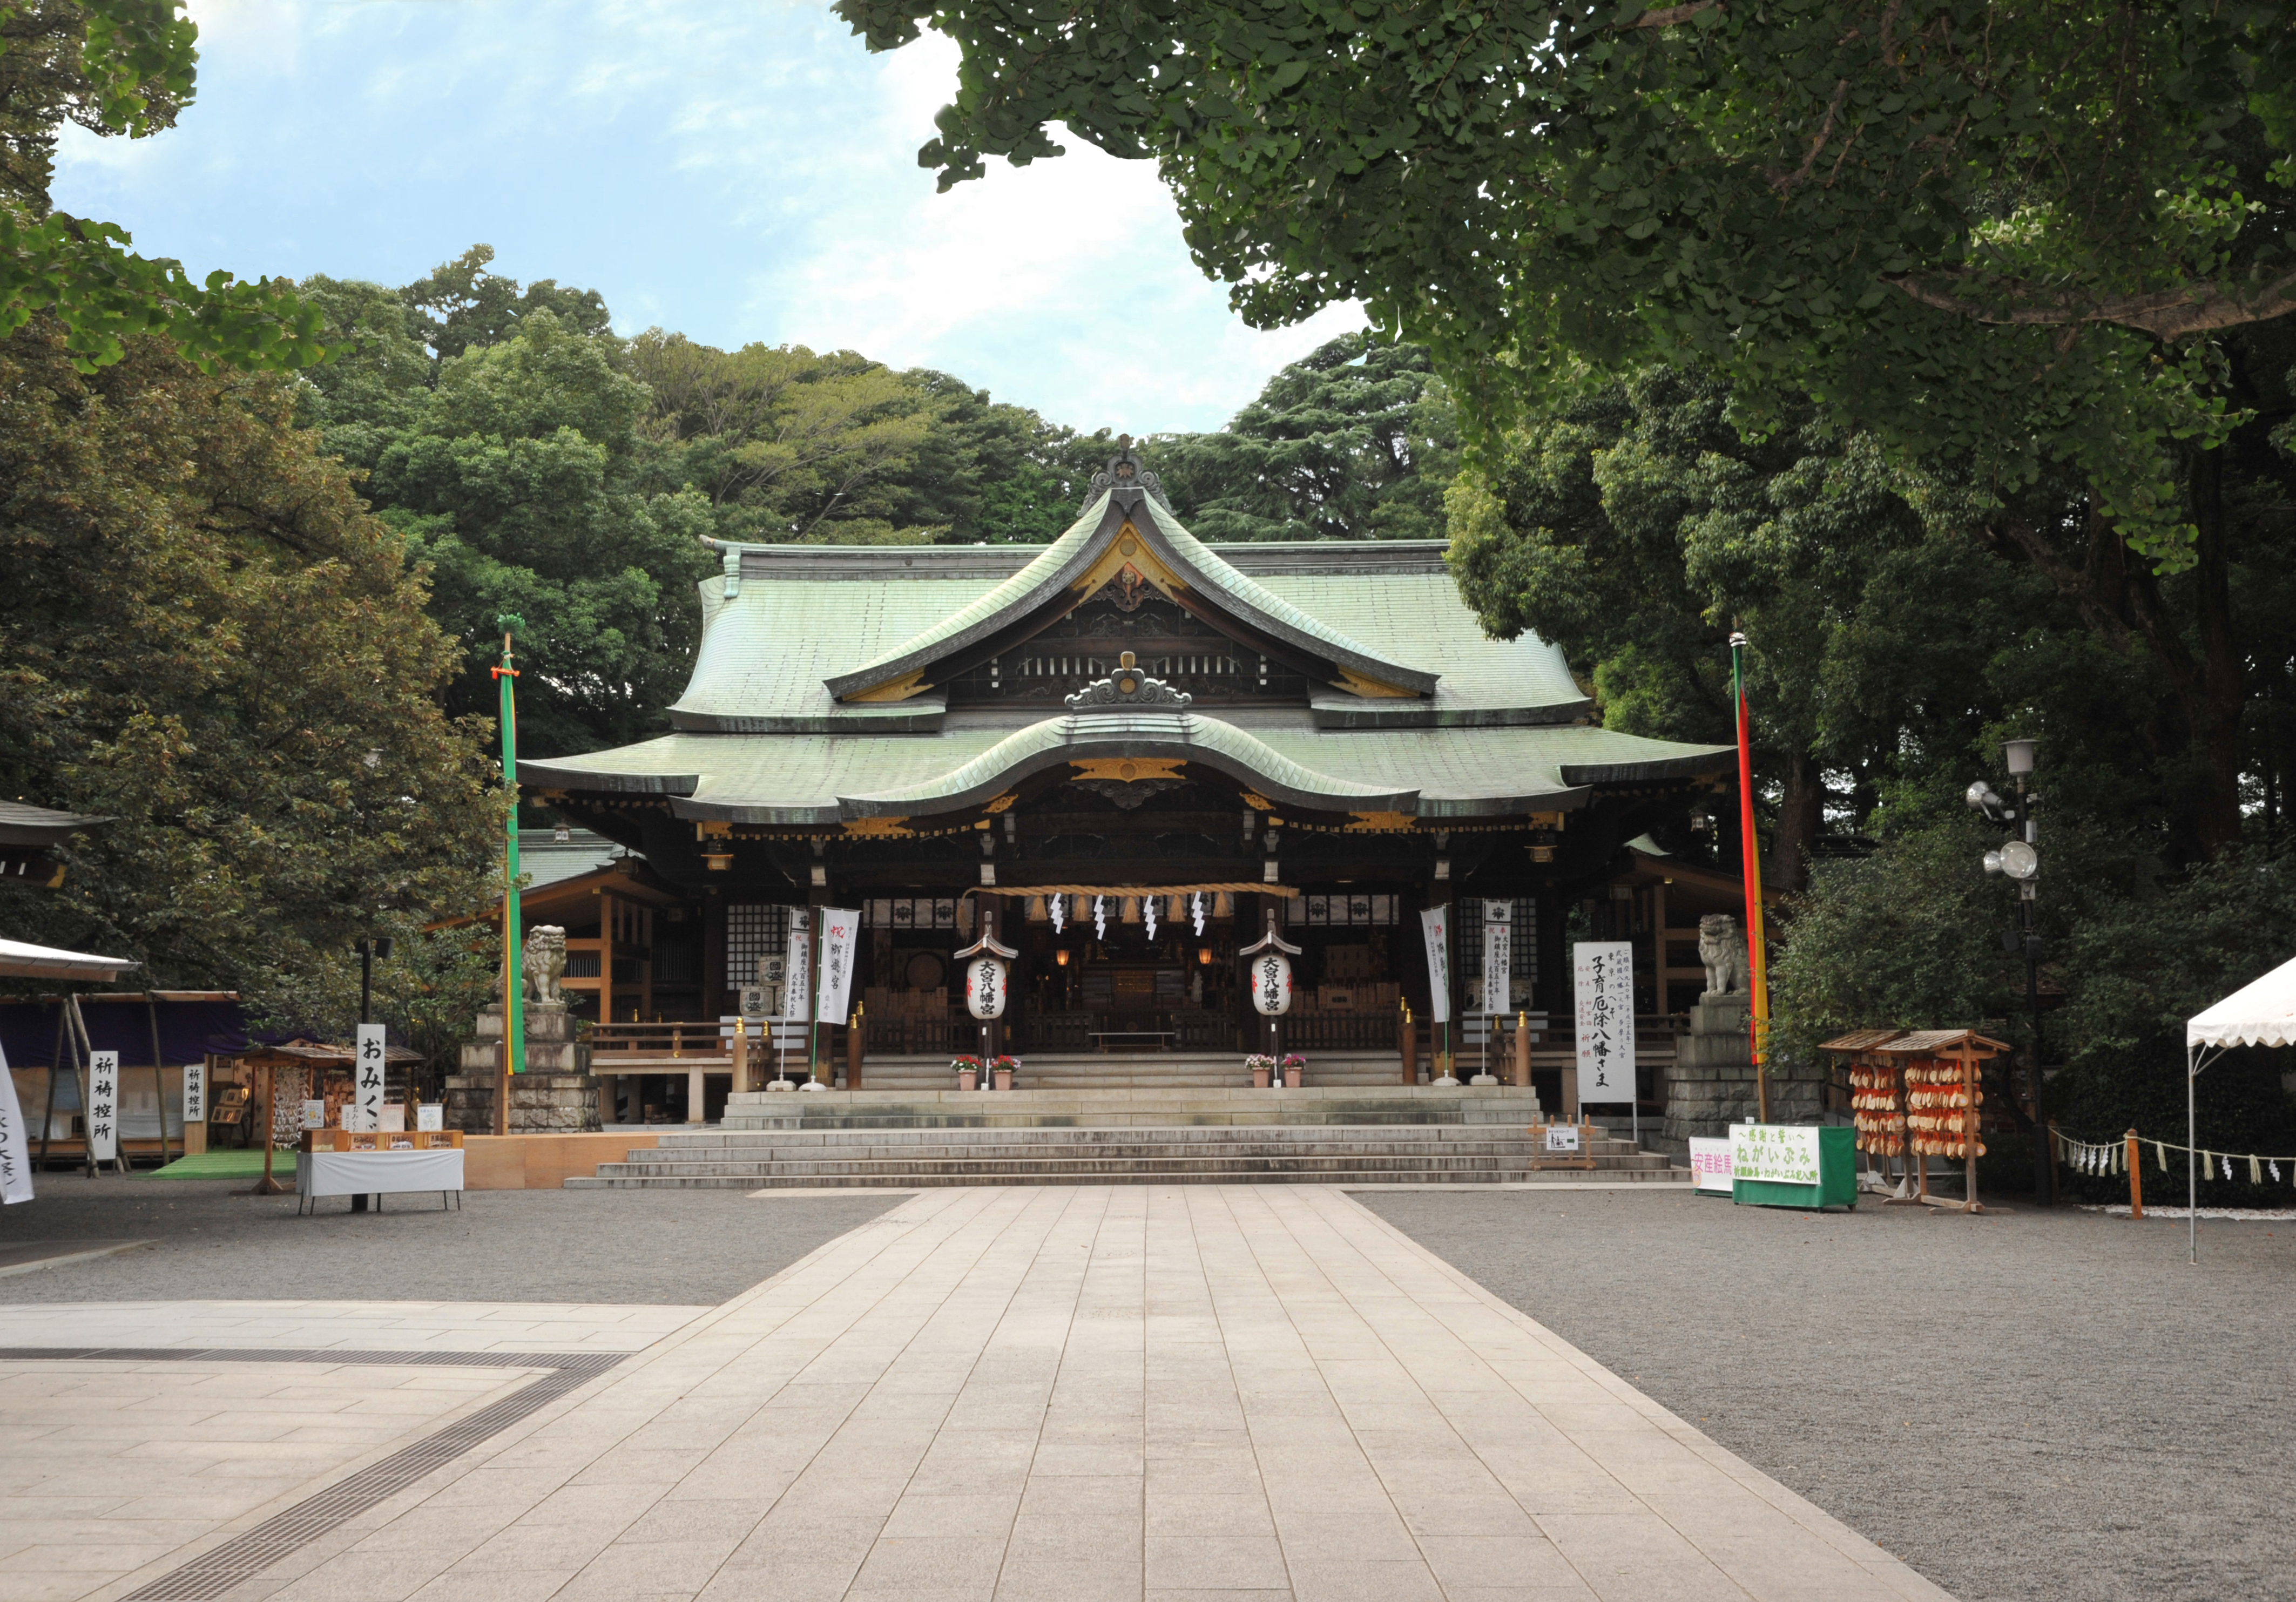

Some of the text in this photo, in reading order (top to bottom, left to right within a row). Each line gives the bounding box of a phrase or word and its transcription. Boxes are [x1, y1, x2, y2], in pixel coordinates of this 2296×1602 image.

[798, 943, 808, 1002] 御鎮座九百五十年
[1501, 935, 1509, 974] 大宮八幡宮
[978, 961, 996, 1015] 大宮八幡宮
[1262, 957, 1280, 1011] 大宮八幡宮
[1608, 952, 1616, 1019] 東京のへそ
[1581, 1033, 1591, 1058] 祈願
[1591, 955, 1611, 1087] 子育厄除八幡さま
[361, 1037, 381, 1130] おみく
[1694, 1152, 1732, 1175] 安産絵馬
[1737, 1144, 1811, 1165] ねがいぶみ
